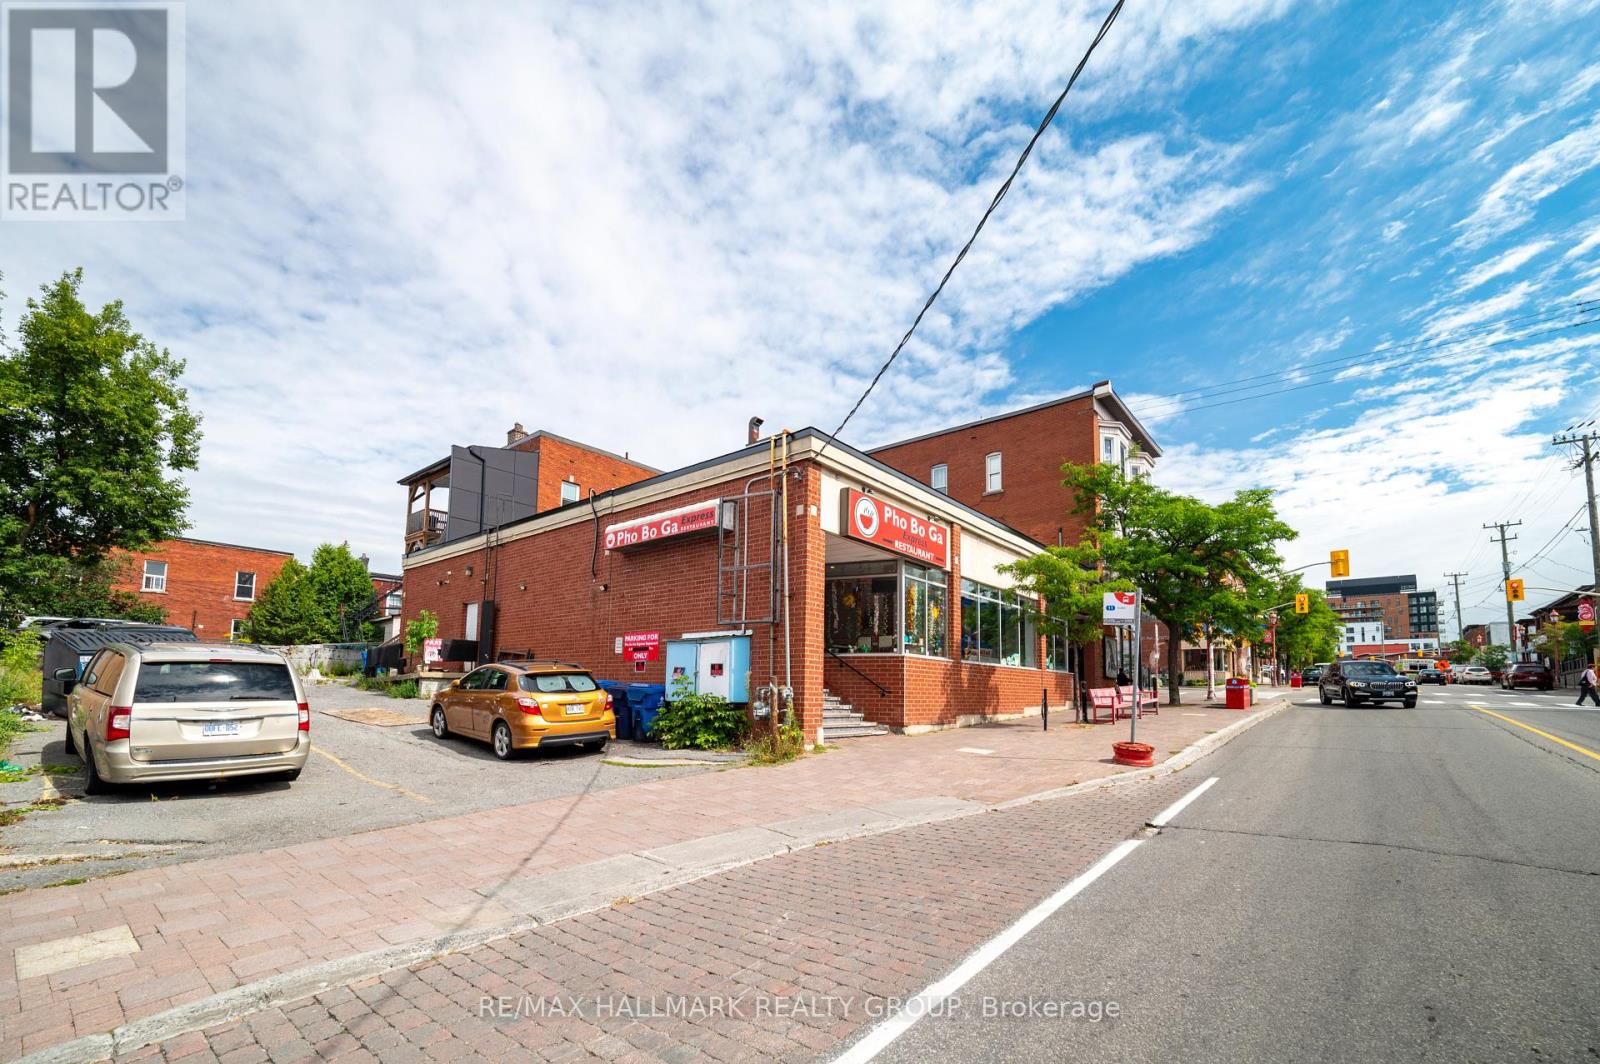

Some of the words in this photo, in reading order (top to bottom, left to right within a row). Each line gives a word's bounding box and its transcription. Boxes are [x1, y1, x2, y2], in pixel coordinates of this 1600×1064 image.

[680, 519, 714, 531] RESTAURANT
[681, 510, 715, 525] Express
[884, 506, 908, 530] Pho
[910, 517, 926, 537] Bo
[928, 526, 944, 545] Ga
[617, 531, 638, 545] Pho
[641, 526, 657, 540] Bo
[661, 520, 679, 534] Ga
[894, 540, 935, 561] RESTAURANT
[624, 634, 647, 642] PARKING
